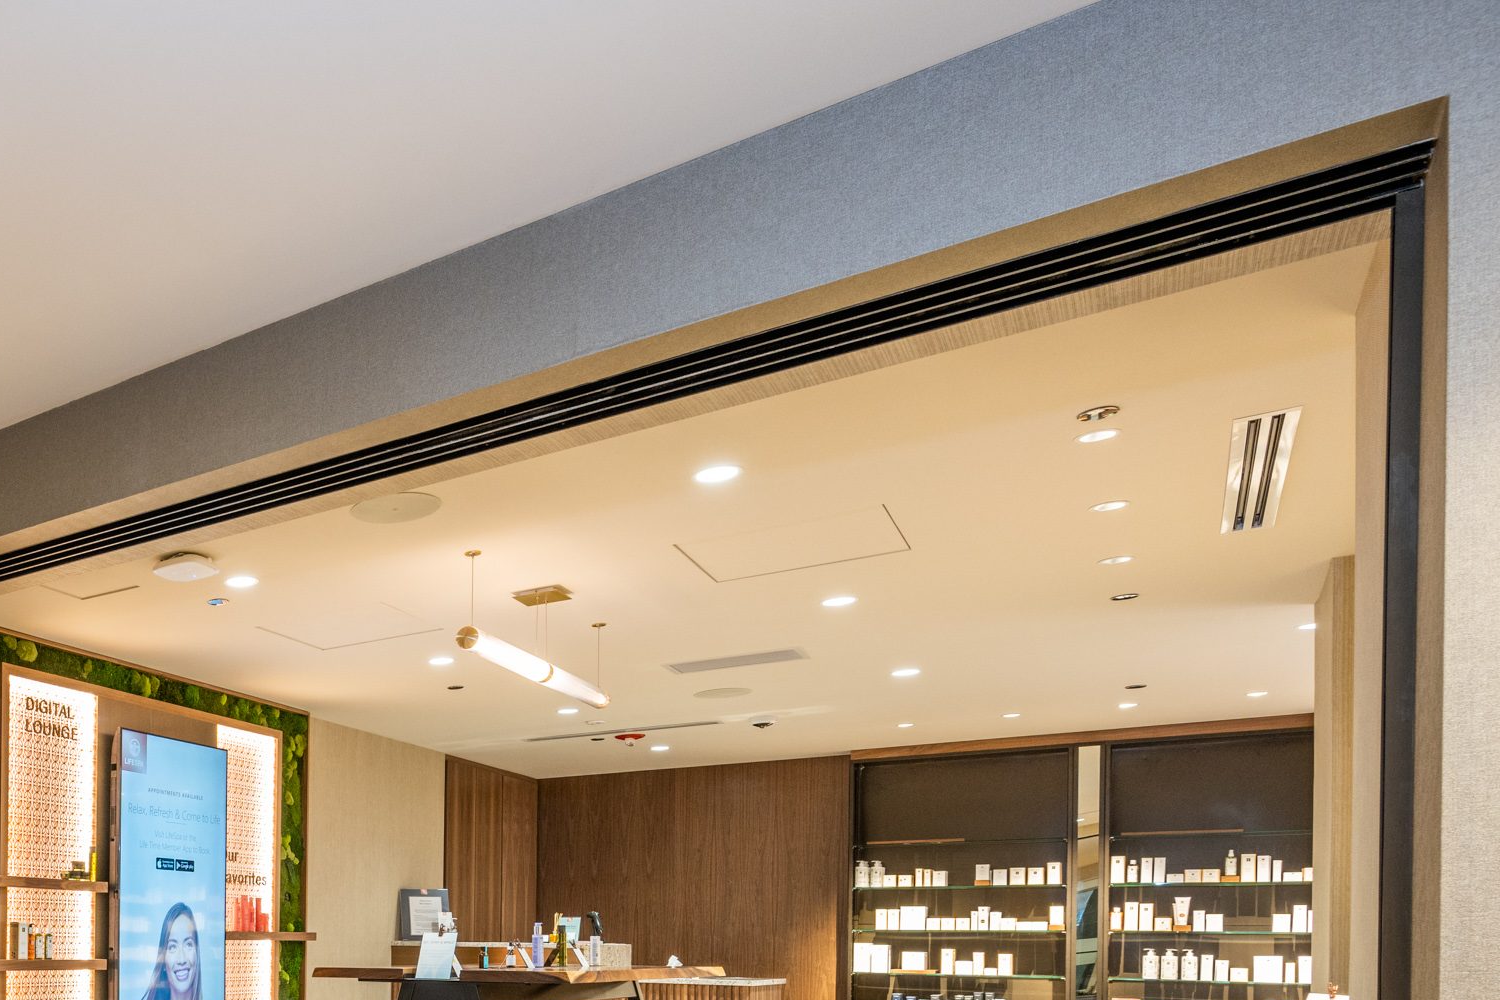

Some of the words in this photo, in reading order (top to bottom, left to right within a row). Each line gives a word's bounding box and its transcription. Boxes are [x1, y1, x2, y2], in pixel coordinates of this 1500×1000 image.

[25, 696, 75, 719] DIGITAL
[25, 719, 78, 741] LOUNGE
[148, 787, 181, 798] APPOINTMENTS
[182, 792, 204, 801] AVAILABLE
[128, 802, 147, 816] Relax,
[149, 805, 174, 819] Refresh
[175, 808, 181, 820] &
[182, 809, 201, 823] Come
[202, 813, 209, 824] to
[210, 813, 221, 825] Life
[226, 850, 239, 862] ur
[226, 871, 267, 887] avorites
